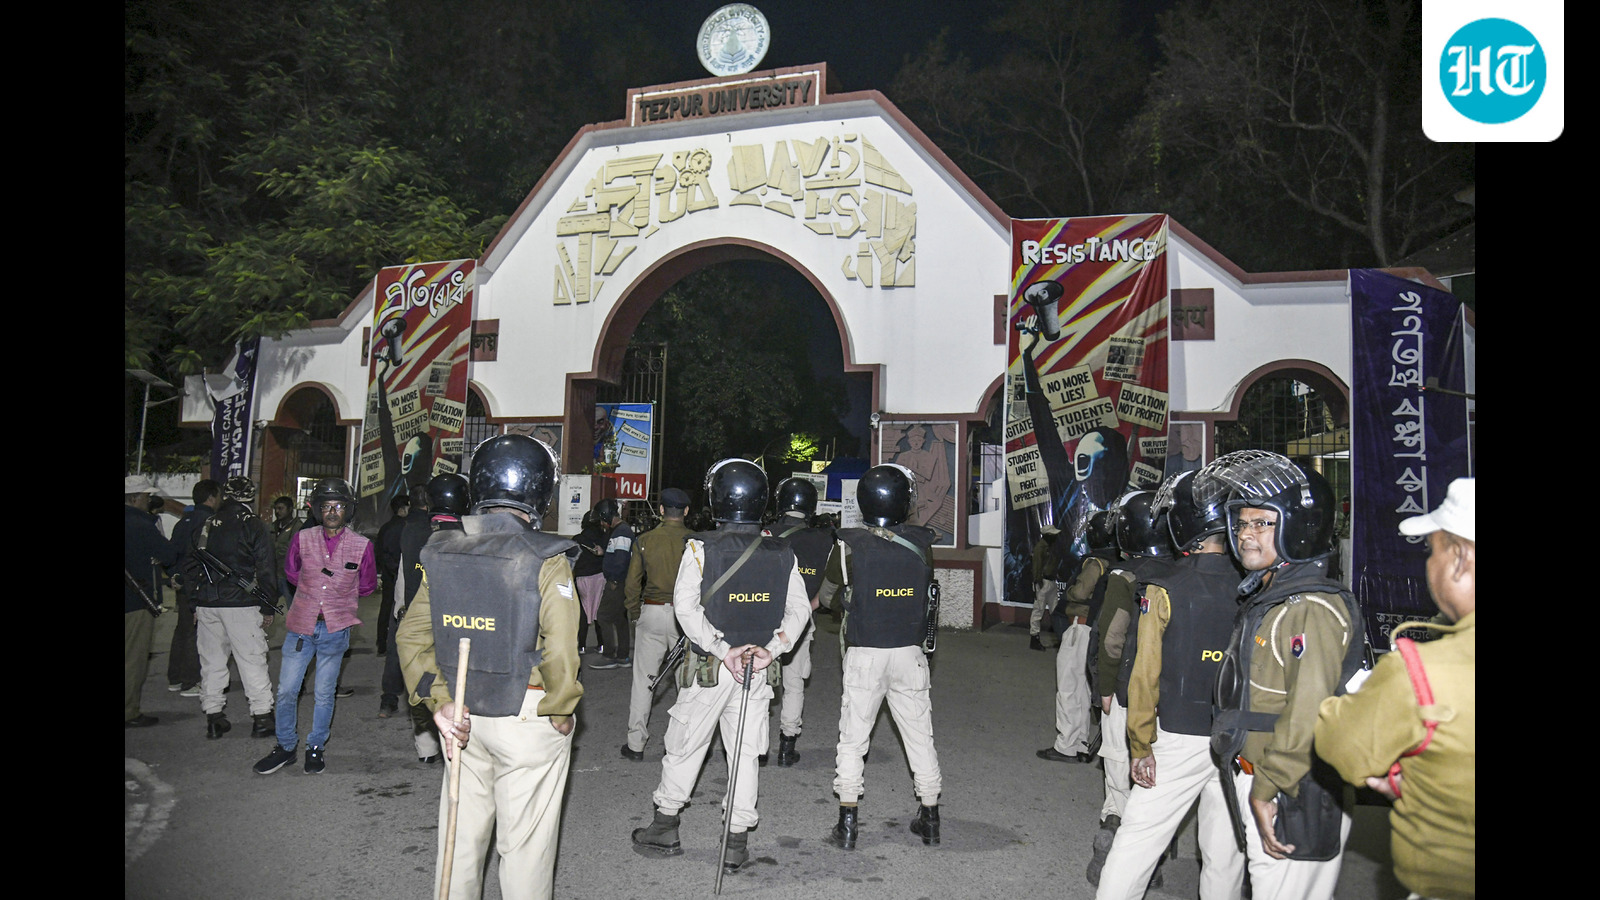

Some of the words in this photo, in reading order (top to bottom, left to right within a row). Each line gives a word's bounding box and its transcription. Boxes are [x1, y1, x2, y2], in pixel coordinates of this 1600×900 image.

[639, 94, 703, 122] TEZPUR
[708, 79, 812, 114] UNIVERSITY
[1021, 237, 1159, 265] RESISTANCE
[1047, 380, 1061, 393] NO
[1062, 372, 1091, 389] MORE
[391, 397, 400, 408] NO
[401, 390, 419, 401] MORE
[1061, 386, 1086, 404] LIES!
[1121, 390, 1167, 411] EDUCATION
[399, 402, 414, 416] LIES!
[433, 402, 464, 418] EDUCATION
[1053, 402, 1114, 428] STUDENTS
[1118, 402, 1134, 415] NOT
[1135, 407, 1164, 424] PROFIT!
[431, 412, 439, 422] NOT
[439, 415, 461, 429] PROFIT!
[221, 433, 231, 466] SAVE
[1008, 450, 1039, 466] STUDENTS
[362, 452, 382, 465] STUDENTS
[1015, 462, 1036, 475] UNITE!
[1135, 467, 1158, 481] FREEDOM
[1020, 478, 1037, 490] FIGHT
[797, 567, 816, 576] OLICE
[728, 592, 770, 603] POLICE
[876, 587, 914, 598] POLICE
[442, 614, 495, 632] POLICE
